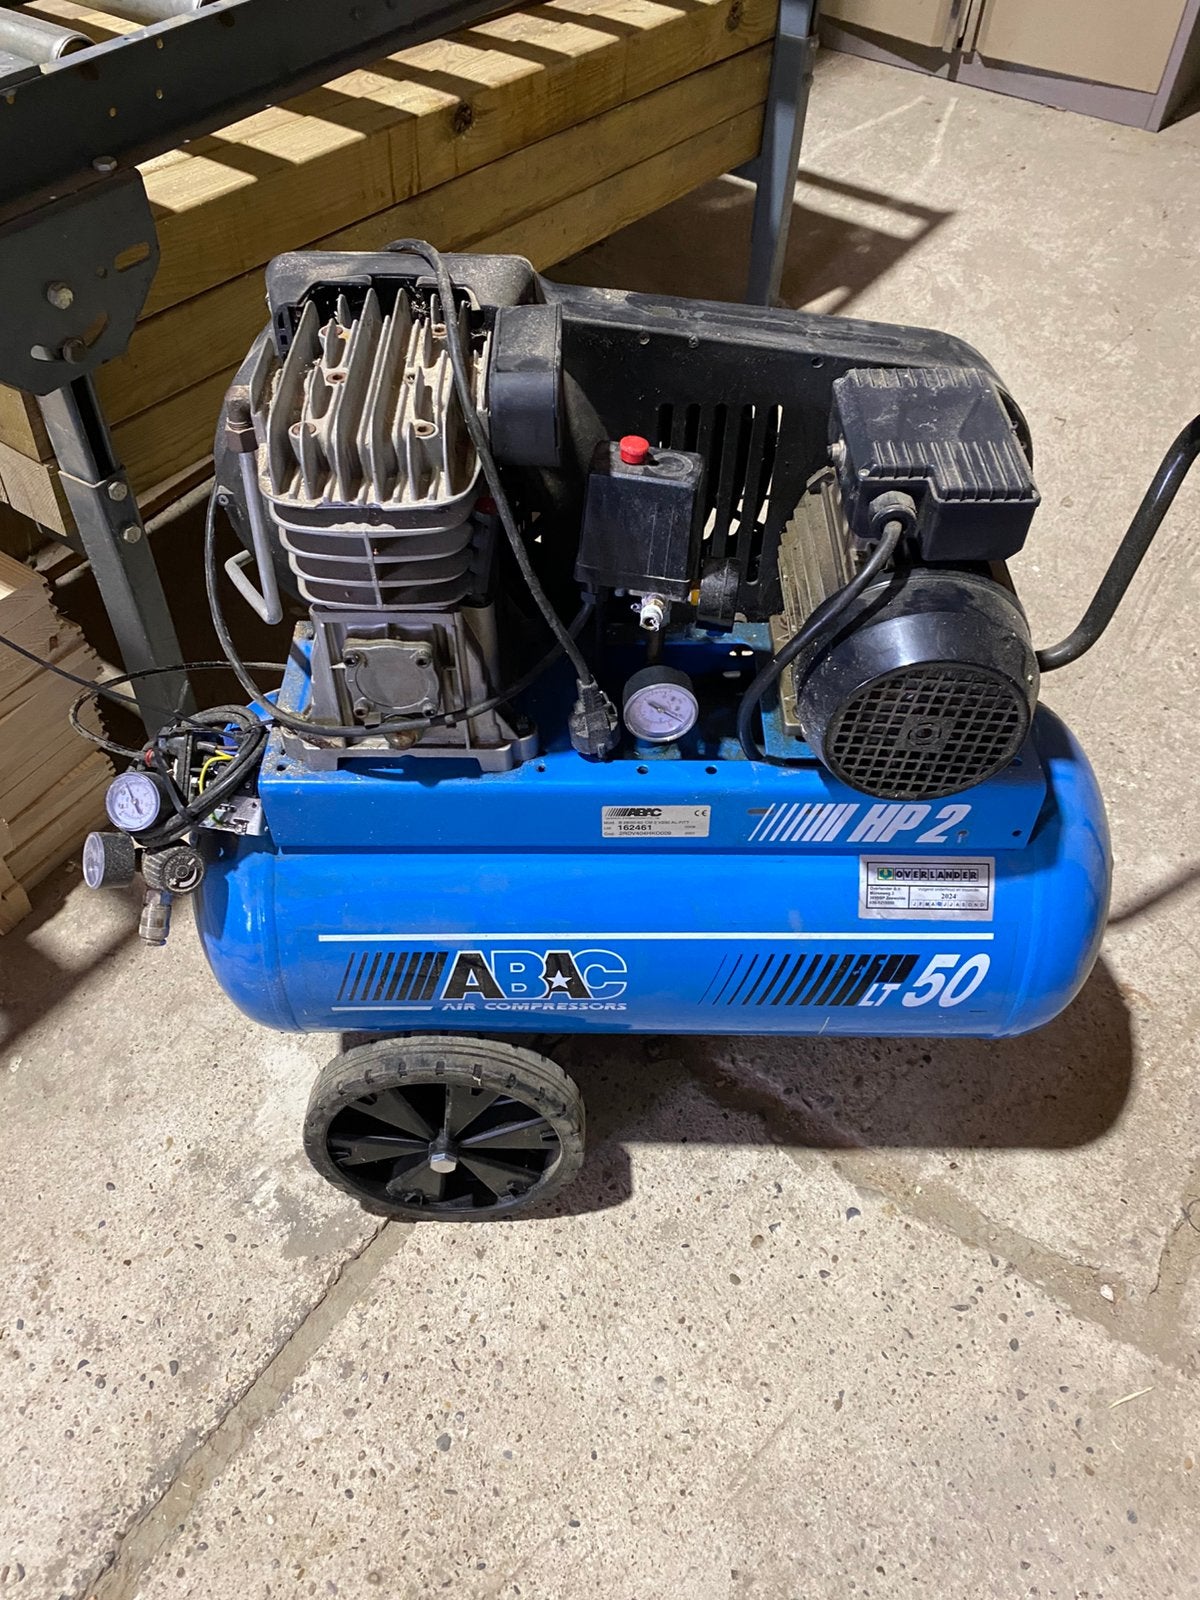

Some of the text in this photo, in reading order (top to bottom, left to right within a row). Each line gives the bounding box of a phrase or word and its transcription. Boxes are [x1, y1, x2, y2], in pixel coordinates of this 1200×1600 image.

[628, 808, 662, 816] ABAC
[846, 803, 972, 843] HP 2
[896, 870, 977, 879] OVERLANDER
[440, 949, 628, 1000] ABAC
[858, 953, 991, 1008] LT 50
[484, 1003, 627, 1011] COMPRESSORS
